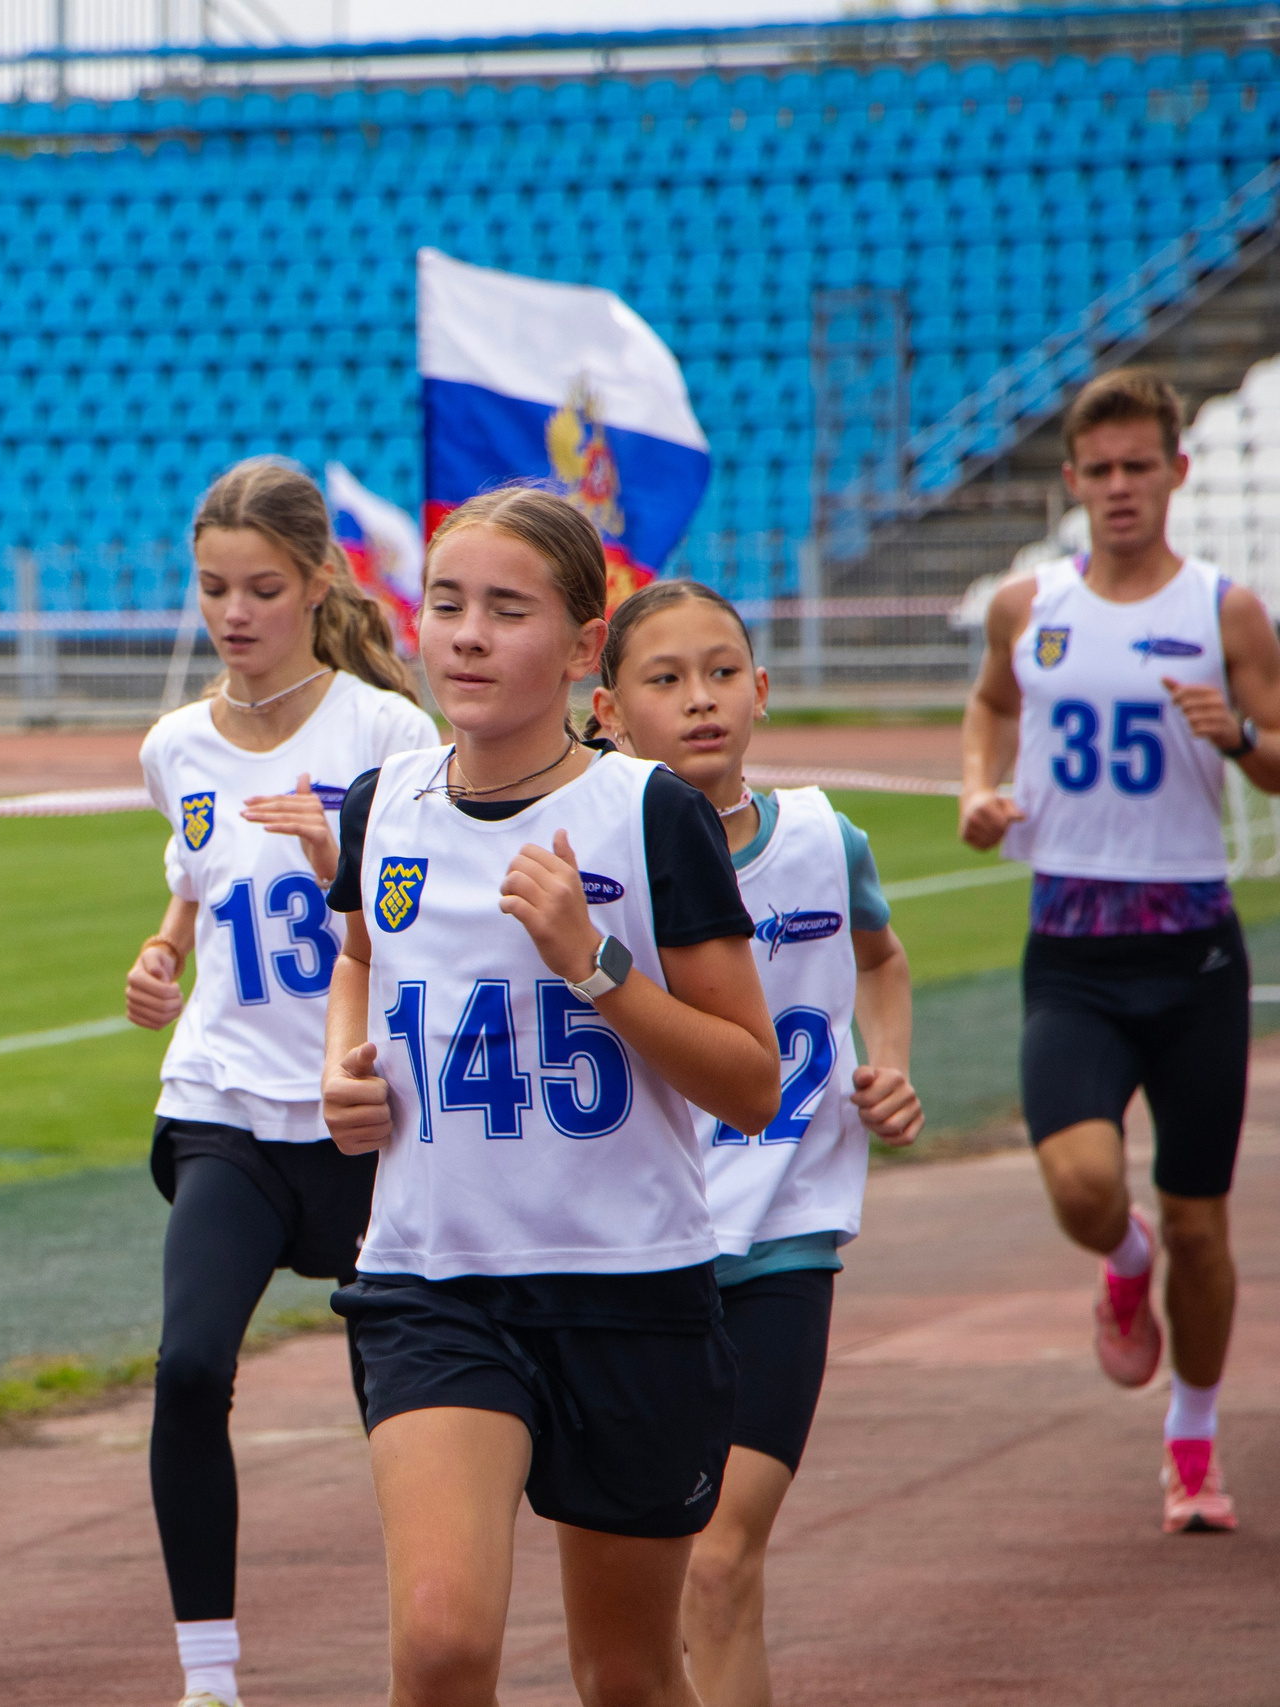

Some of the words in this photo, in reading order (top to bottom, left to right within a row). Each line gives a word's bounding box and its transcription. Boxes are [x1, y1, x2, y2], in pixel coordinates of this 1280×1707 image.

[1050, 698, 1166, 797] 35
[210, 871, 342, 1007] 13
[385, 979, 634, 1144] 145
[712, 1005, 838, 1147] 2
